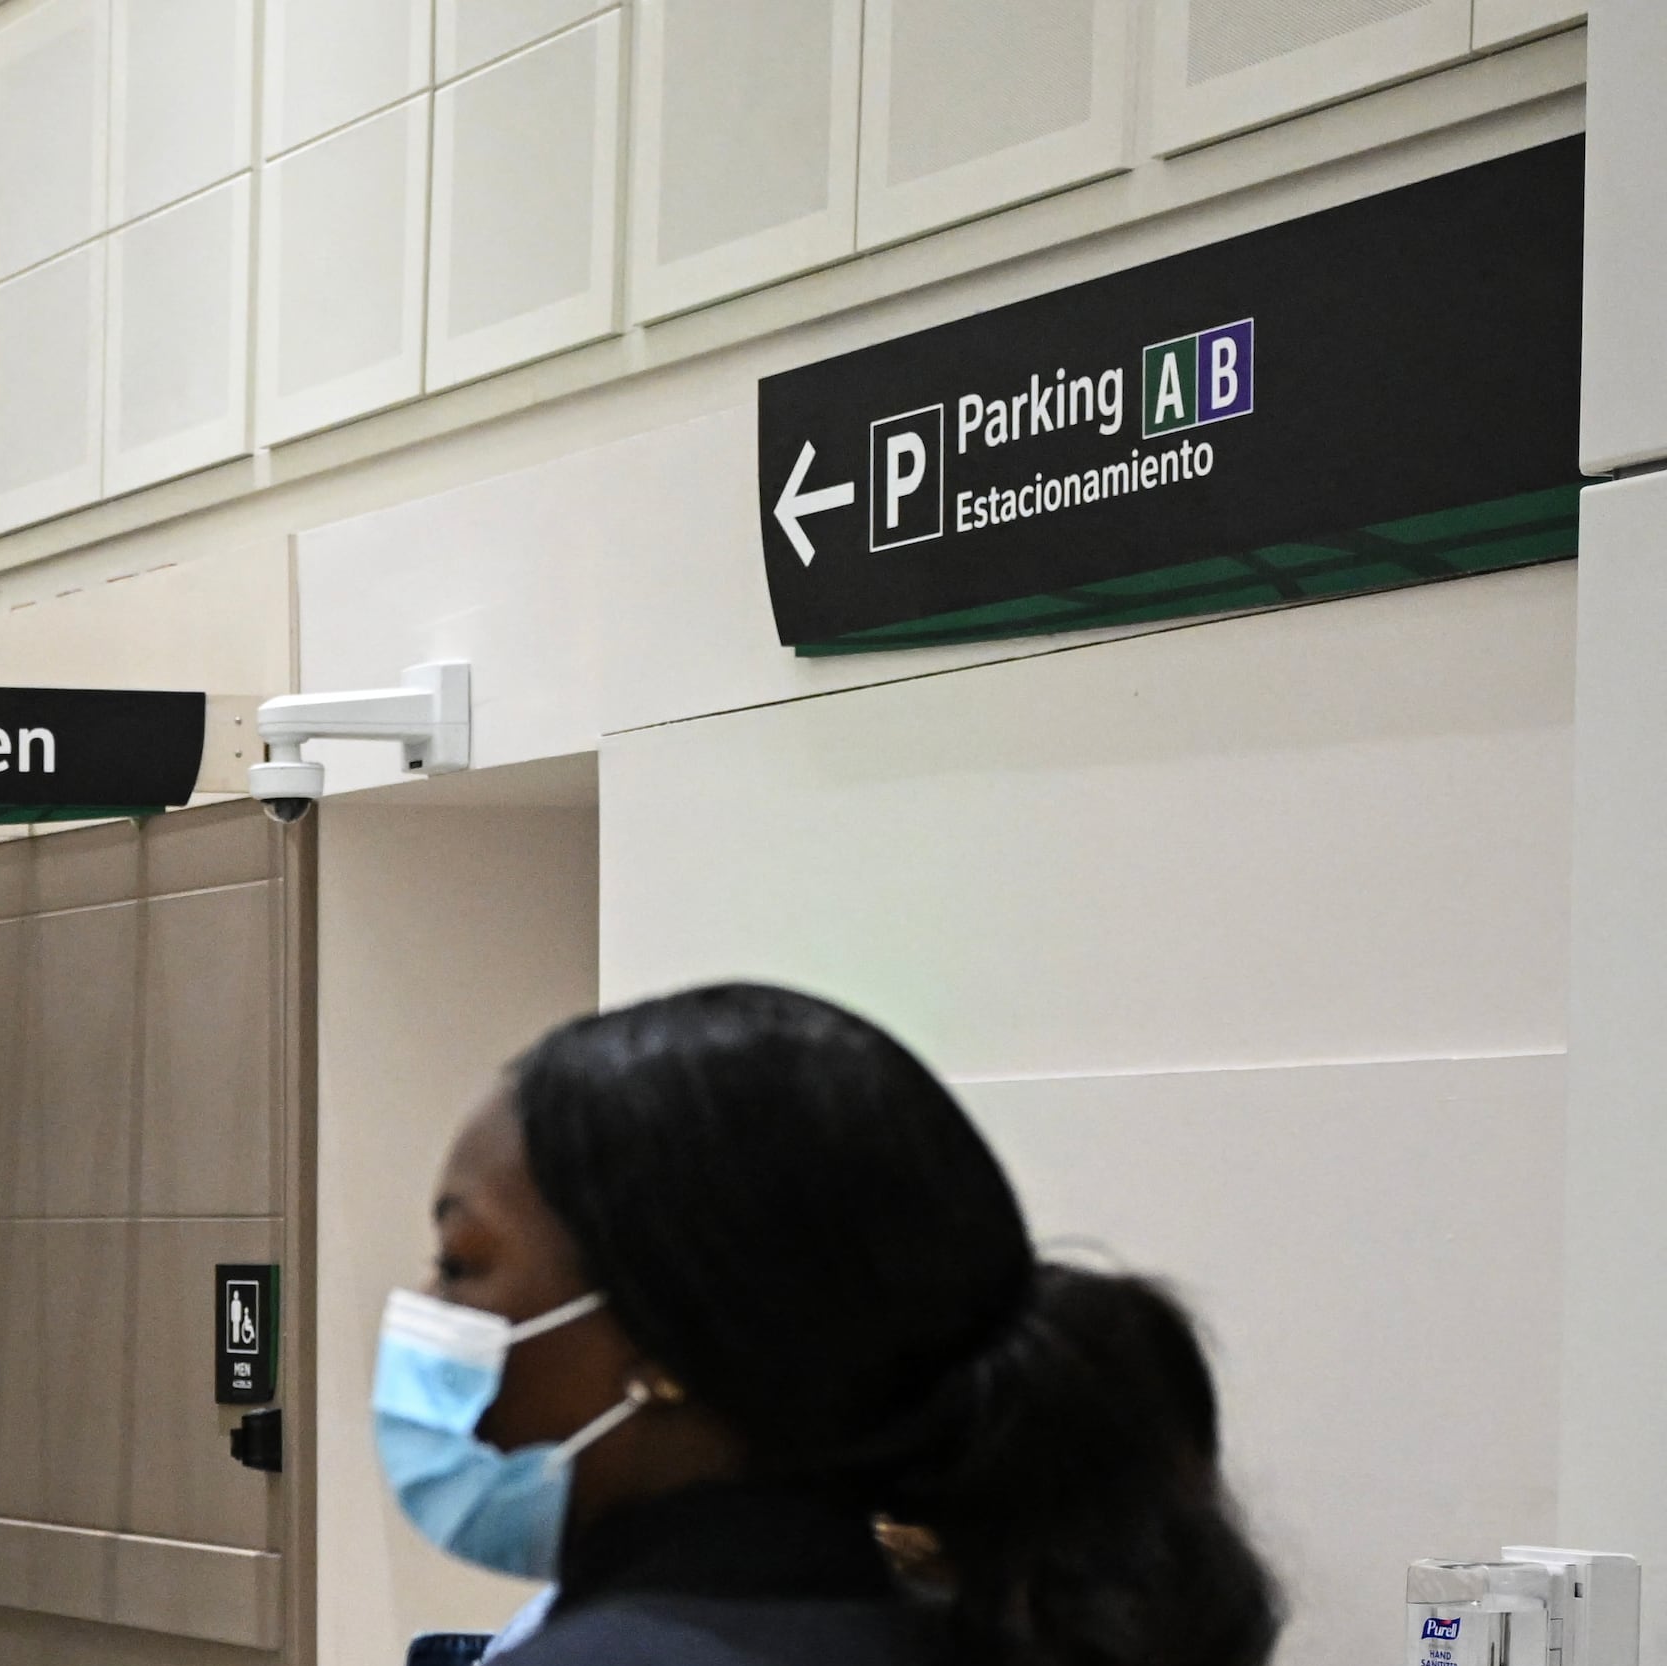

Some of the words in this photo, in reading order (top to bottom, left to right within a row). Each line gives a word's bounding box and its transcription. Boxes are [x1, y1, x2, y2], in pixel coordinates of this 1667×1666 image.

[957, 362, 1124, 455] Parking
[1154, 351, 1186, 425] A
[1211, 336, 1239, 410] B
[885, 431, 927, 529] P
[956, 439, 1214, 533] Estacionamiento
[233, 1362, 252, 1377] MEN
[1427, 1619, 1458, 1638] Purell
[1429, 1649, 1452, 1661] HAND
